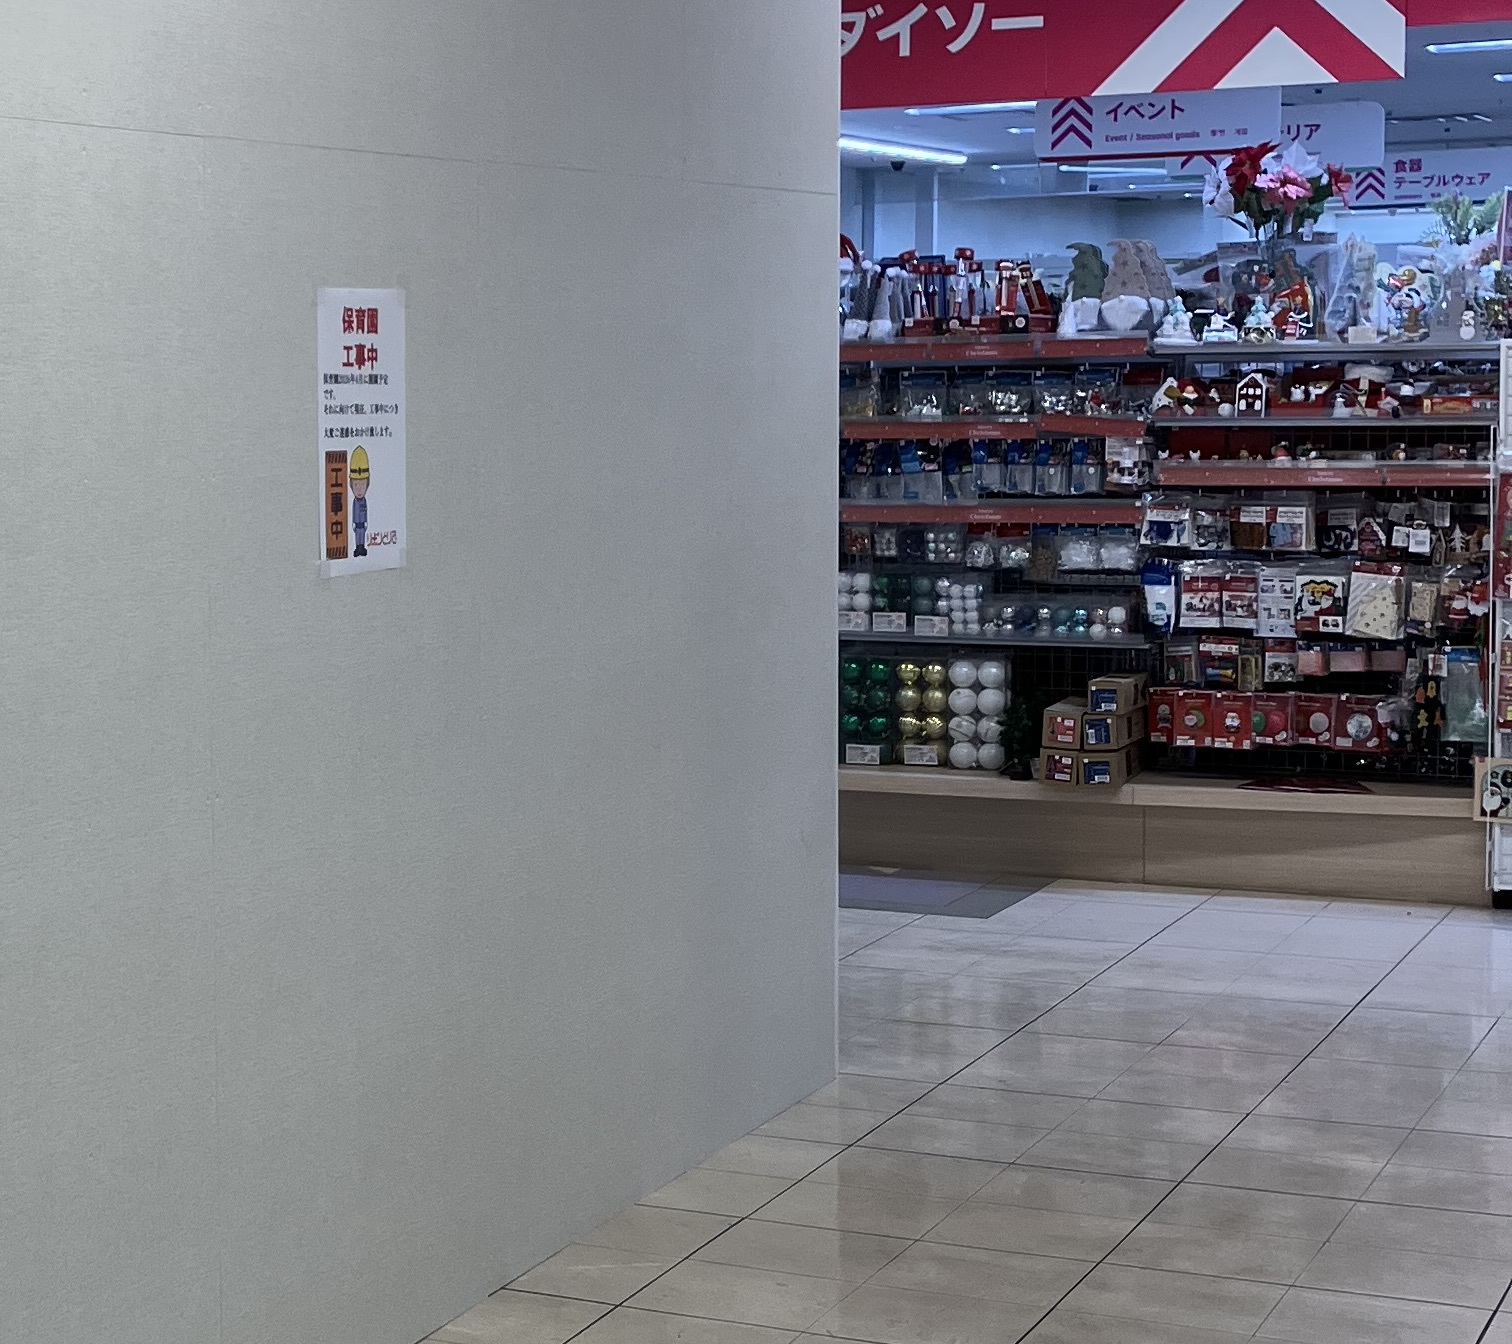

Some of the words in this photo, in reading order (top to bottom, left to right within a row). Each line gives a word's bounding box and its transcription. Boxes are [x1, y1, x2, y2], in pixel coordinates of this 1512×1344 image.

[841, 3, 1044, 57] ダイソー
[1105, 99, 1185, 122] イベント
[1281, 124, 1321, 142] リア
[1393, 159, 1422, 174] 食器
[1394, 172, 1491, 189] テーブルウェア
[342, 306, 378, 334] 保育園
[342, 342, 378, 371] 工事中
[330, 467, 343, 540] 工事中
